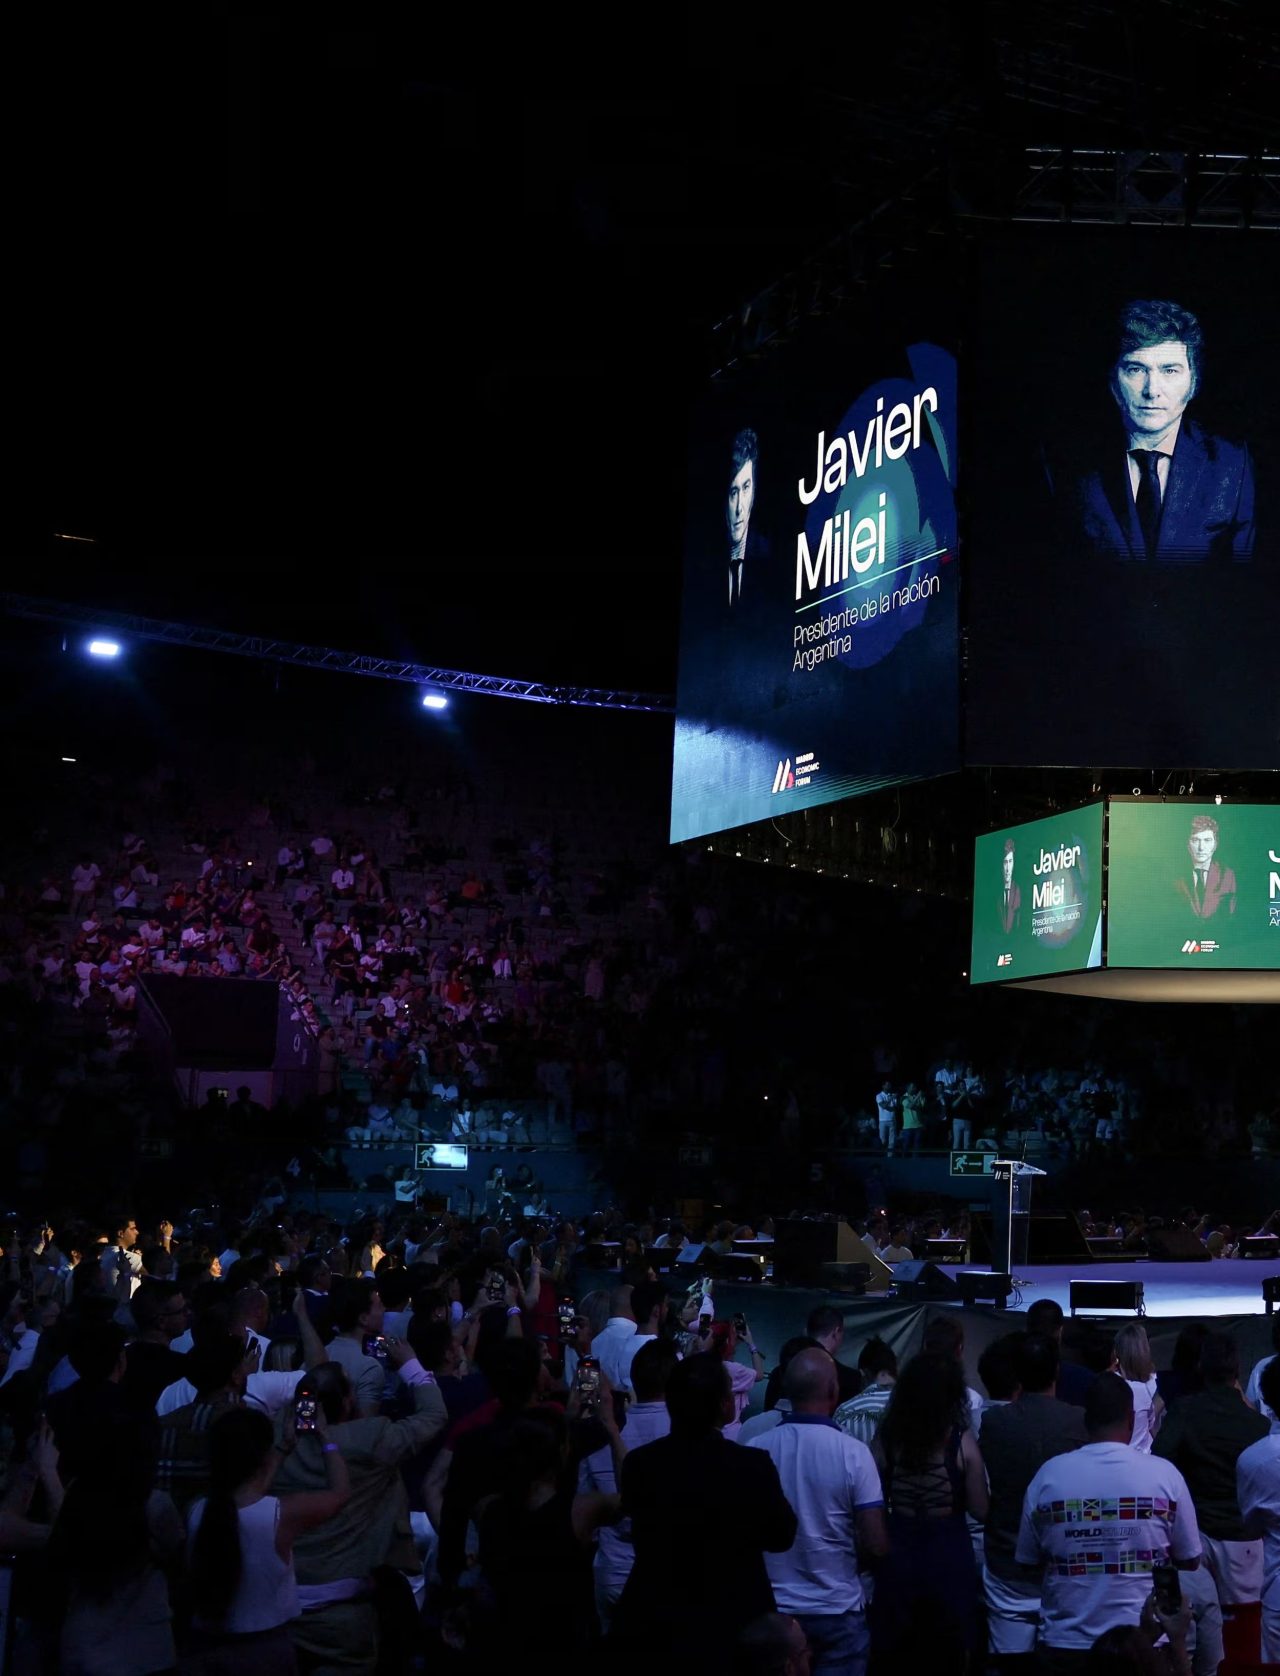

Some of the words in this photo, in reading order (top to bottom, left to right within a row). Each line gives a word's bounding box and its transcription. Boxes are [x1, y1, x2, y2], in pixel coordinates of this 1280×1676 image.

[799, 387, 938, 506] Javier
[796, 494, 887, 601] Milei
[794, 607, 858, 648] Presidente
[860, 597, 877, 621] de
[879, 592, 890, 615] la
[892, 572, 940, 609] nación
[792, 634, 852, 672] Argentina
[1033, 843, 1081, 876] Javier
[1032, 878, 1065, 909] Milei
